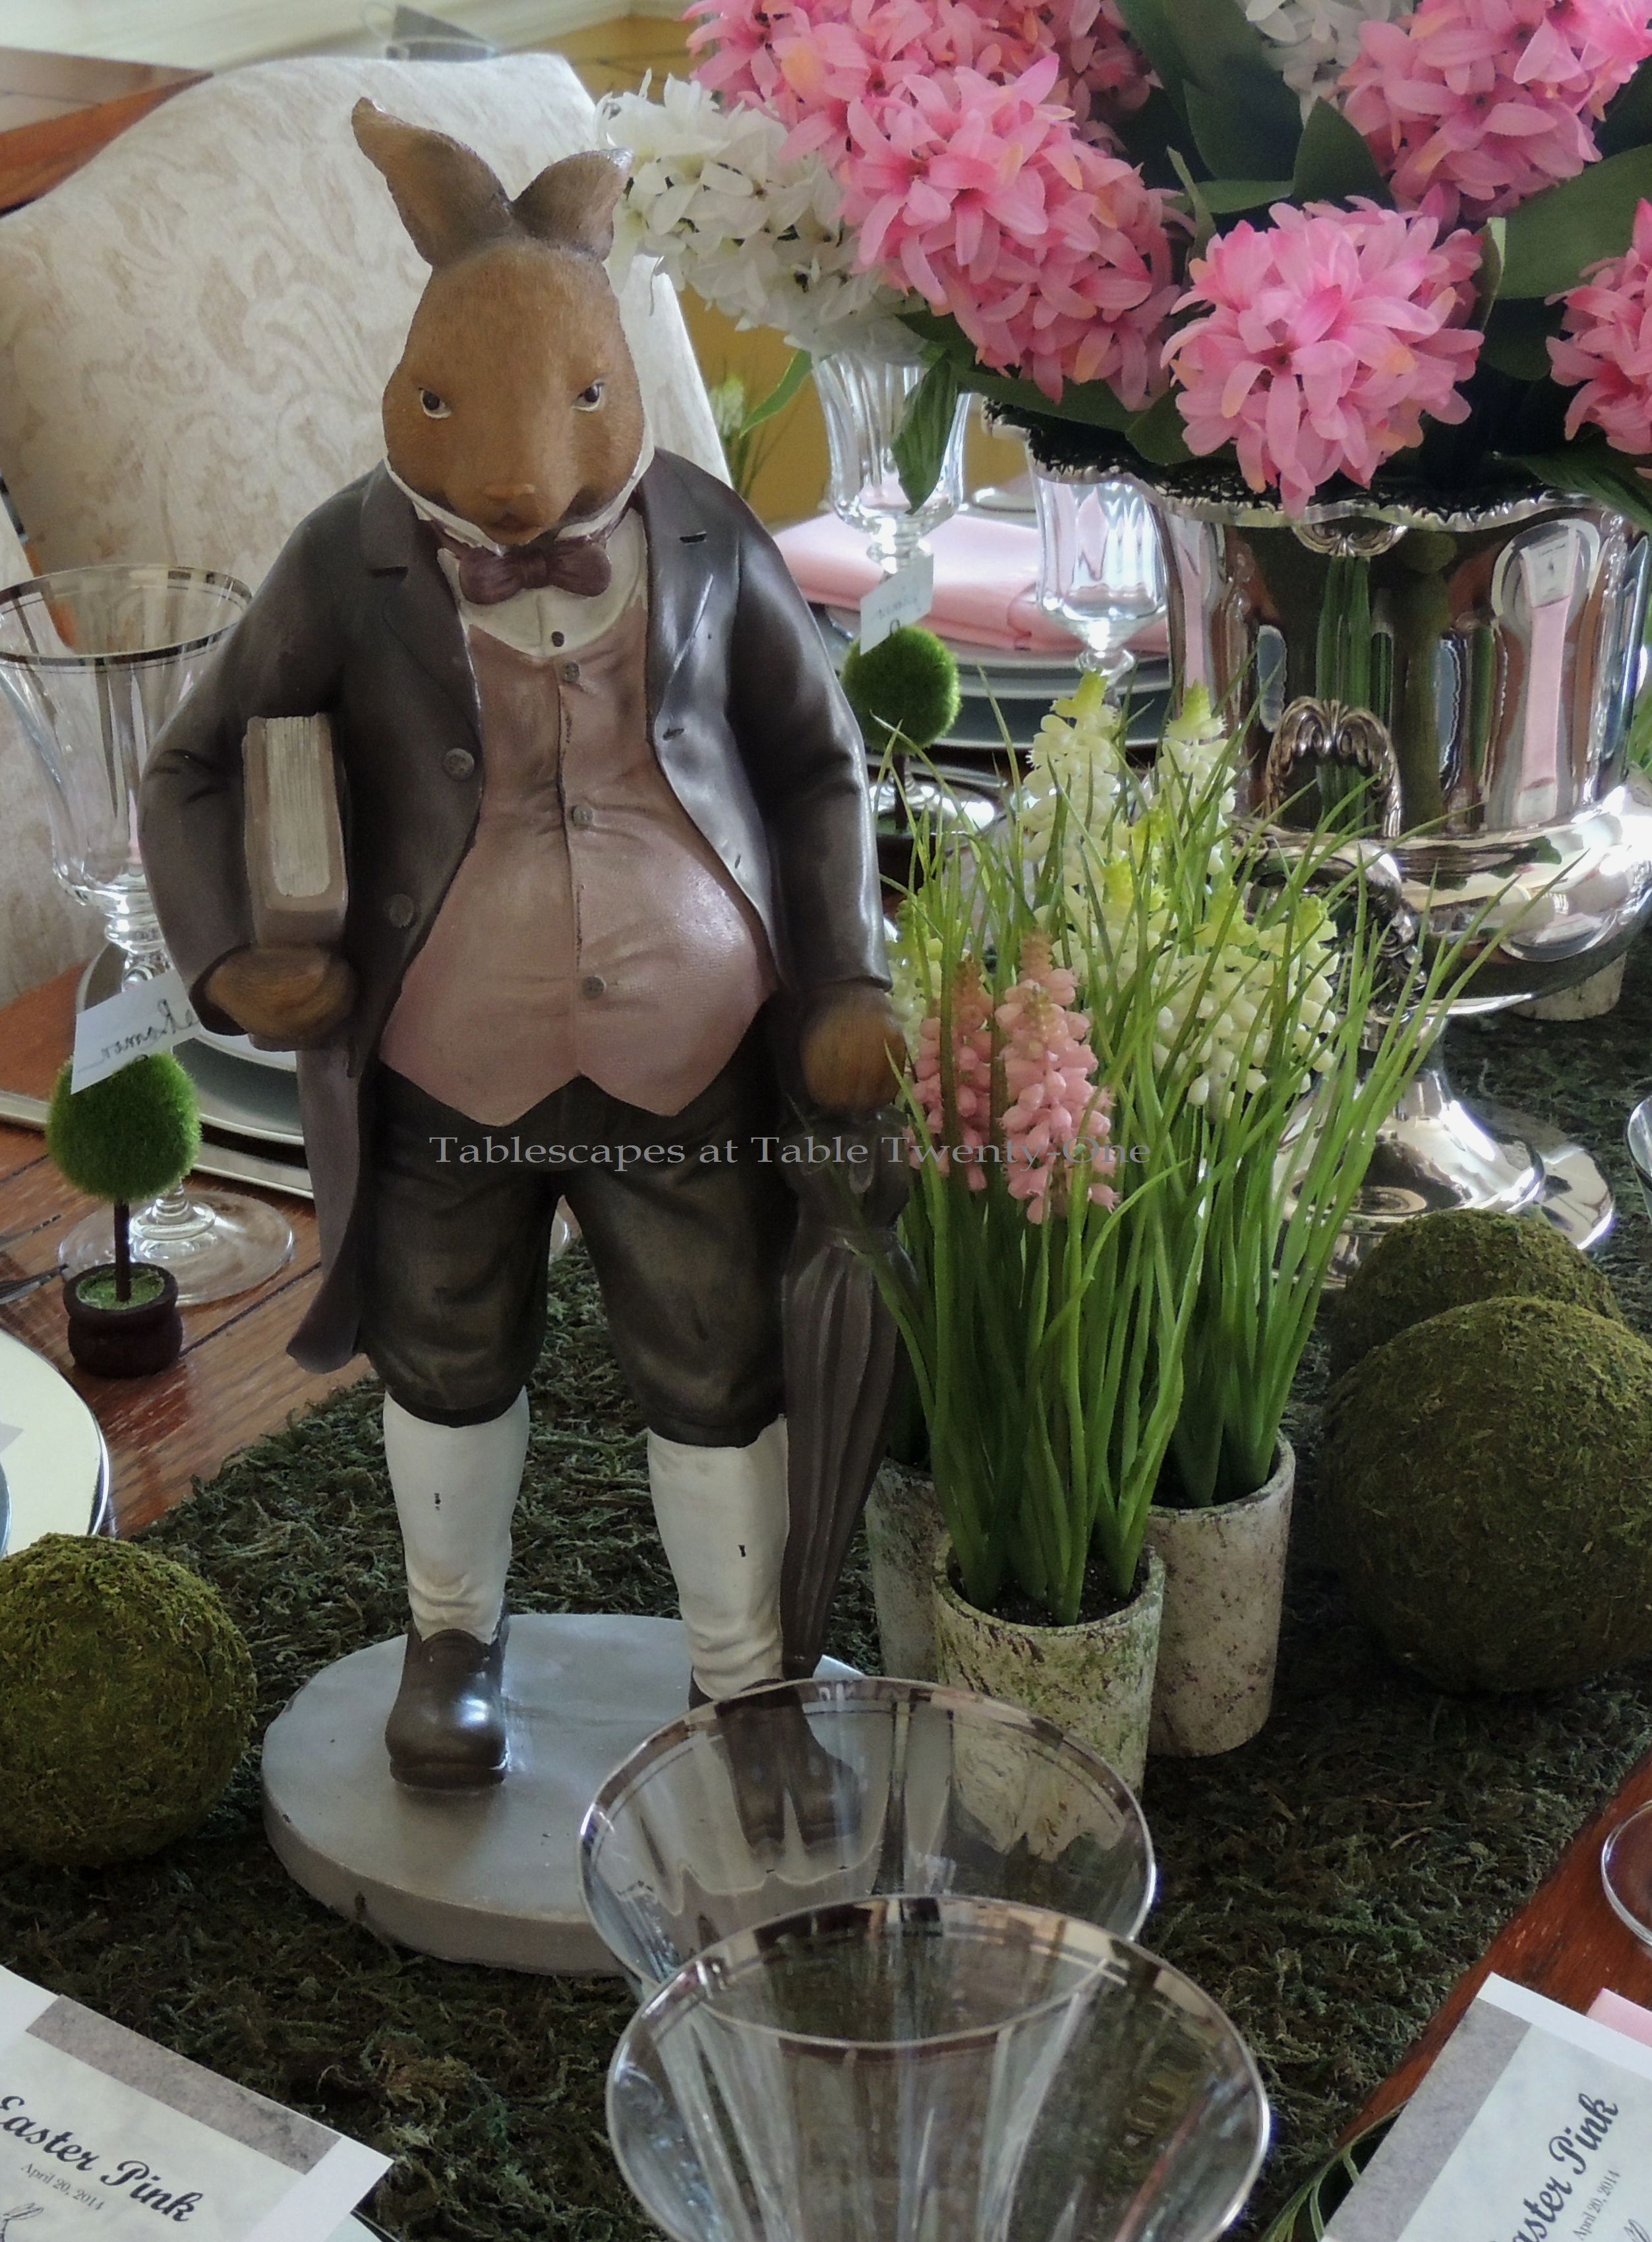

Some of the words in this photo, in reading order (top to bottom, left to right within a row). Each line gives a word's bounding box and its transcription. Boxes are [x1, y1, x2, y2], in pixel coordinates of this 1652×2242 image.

[1549, 2093, 1619, 2175] Pink
[20, 2162, 56, 2184] April
[52, 2177, 71, 2196] 20,
[73, 2188, 106, 2210] 2014
[100, 2160, 204, 2222] Pink
[1572, 2211, 1597, 2241] April
[1587, 2197, 1607, 2214] 20,
[1597, 2169, 1621, 2197] 2014
